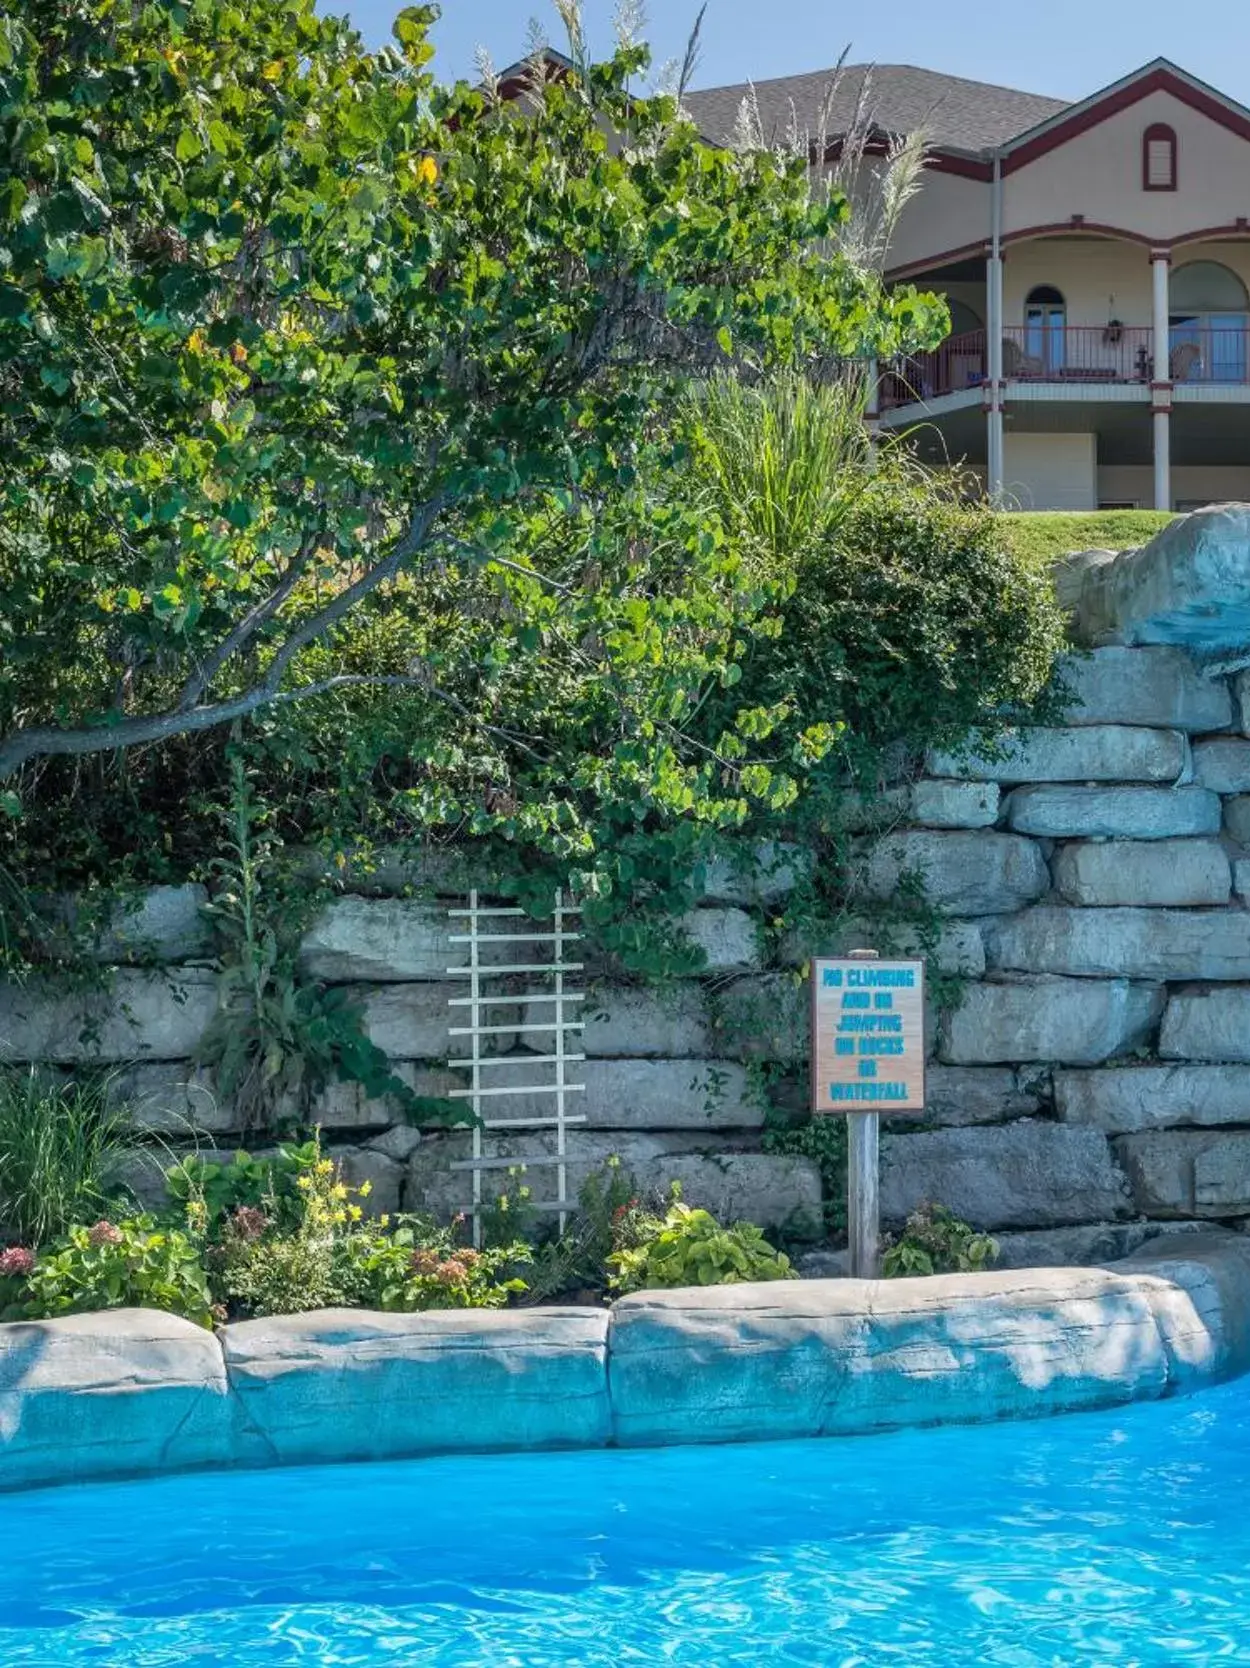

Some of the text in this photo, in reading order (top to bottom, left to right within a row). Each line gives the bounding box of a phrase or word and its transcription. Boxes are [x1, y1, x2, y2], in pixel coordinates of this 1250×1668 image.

[823, 969, 914, 986] NO CLIMBING
[837, 1015, 902, 1032] JUMPING
[829, 1082, 908, 1100] WATERFALL
